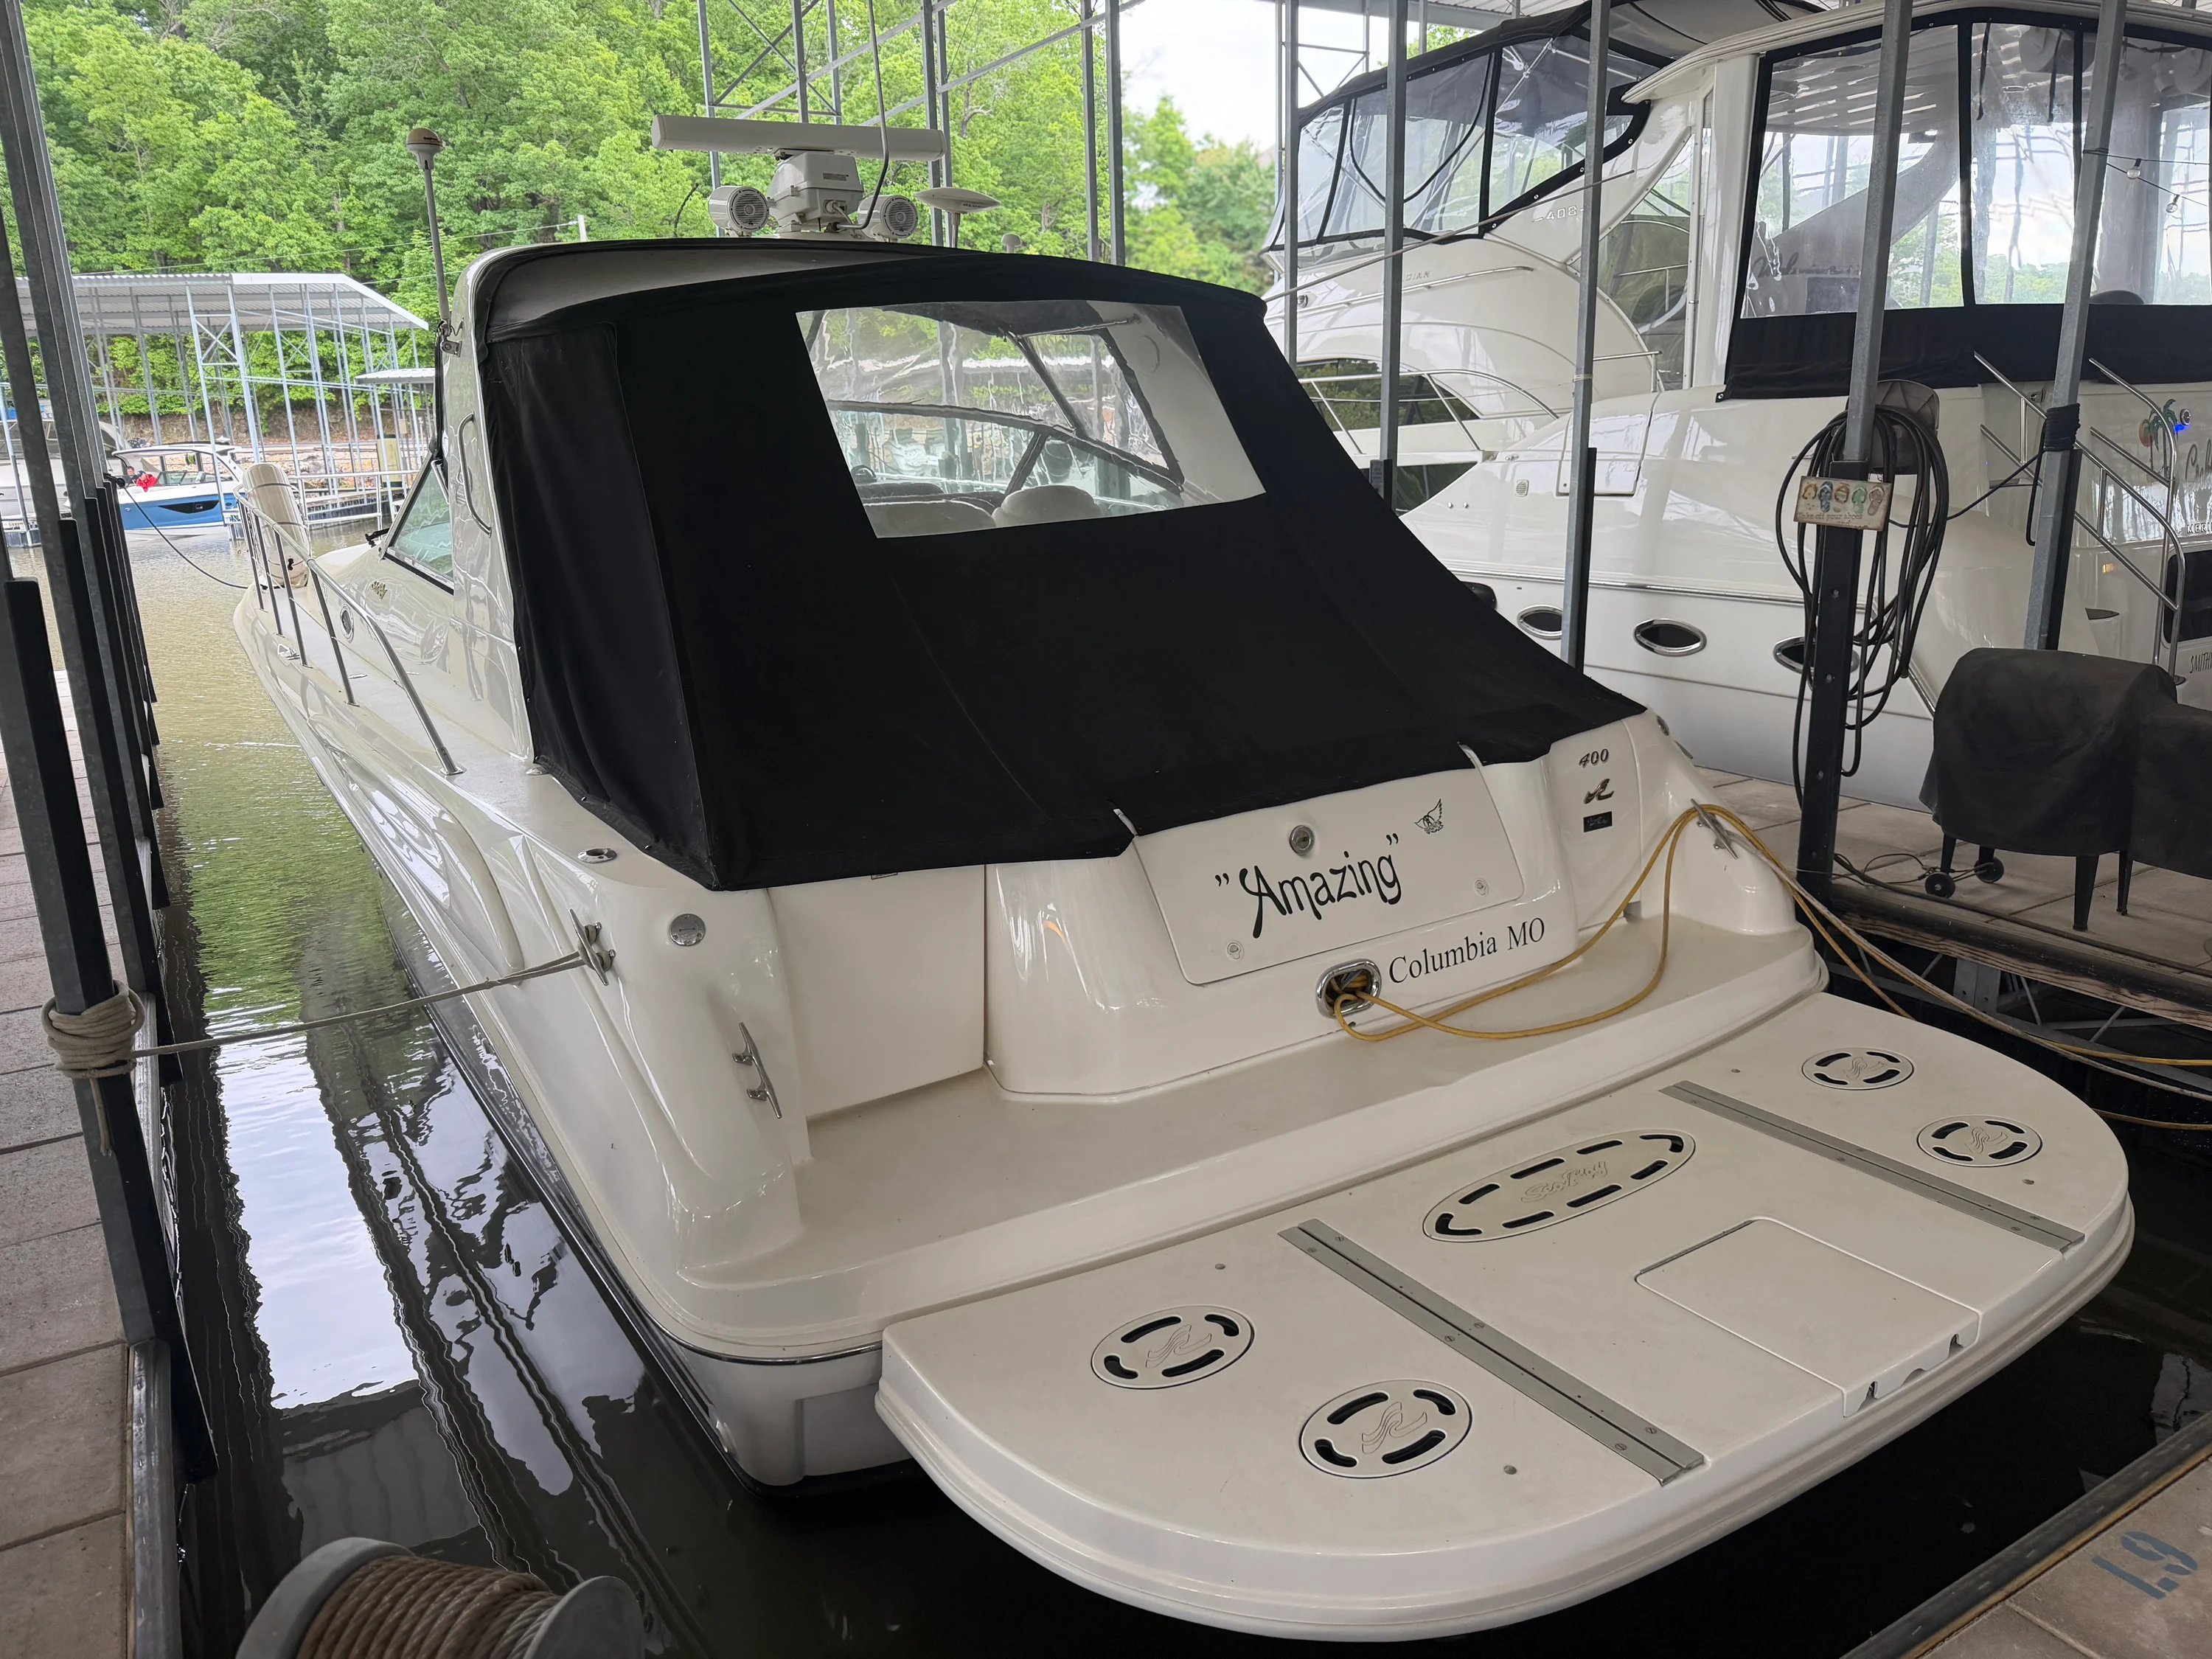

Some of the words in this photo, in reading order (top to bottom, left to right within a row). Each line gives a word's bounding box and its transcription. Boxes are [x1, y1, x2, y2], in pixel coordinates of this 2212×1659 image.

[1545, 206, 1577, 220] 408
[1404, 271, 1430, 282] DIAN
[2186, 522, 2212, 535] MERI
[1579, 748, 1609, 768] 400
[1389, 931, 1498, 984] Columbia
[1506, 917, 1545, 950] MO
